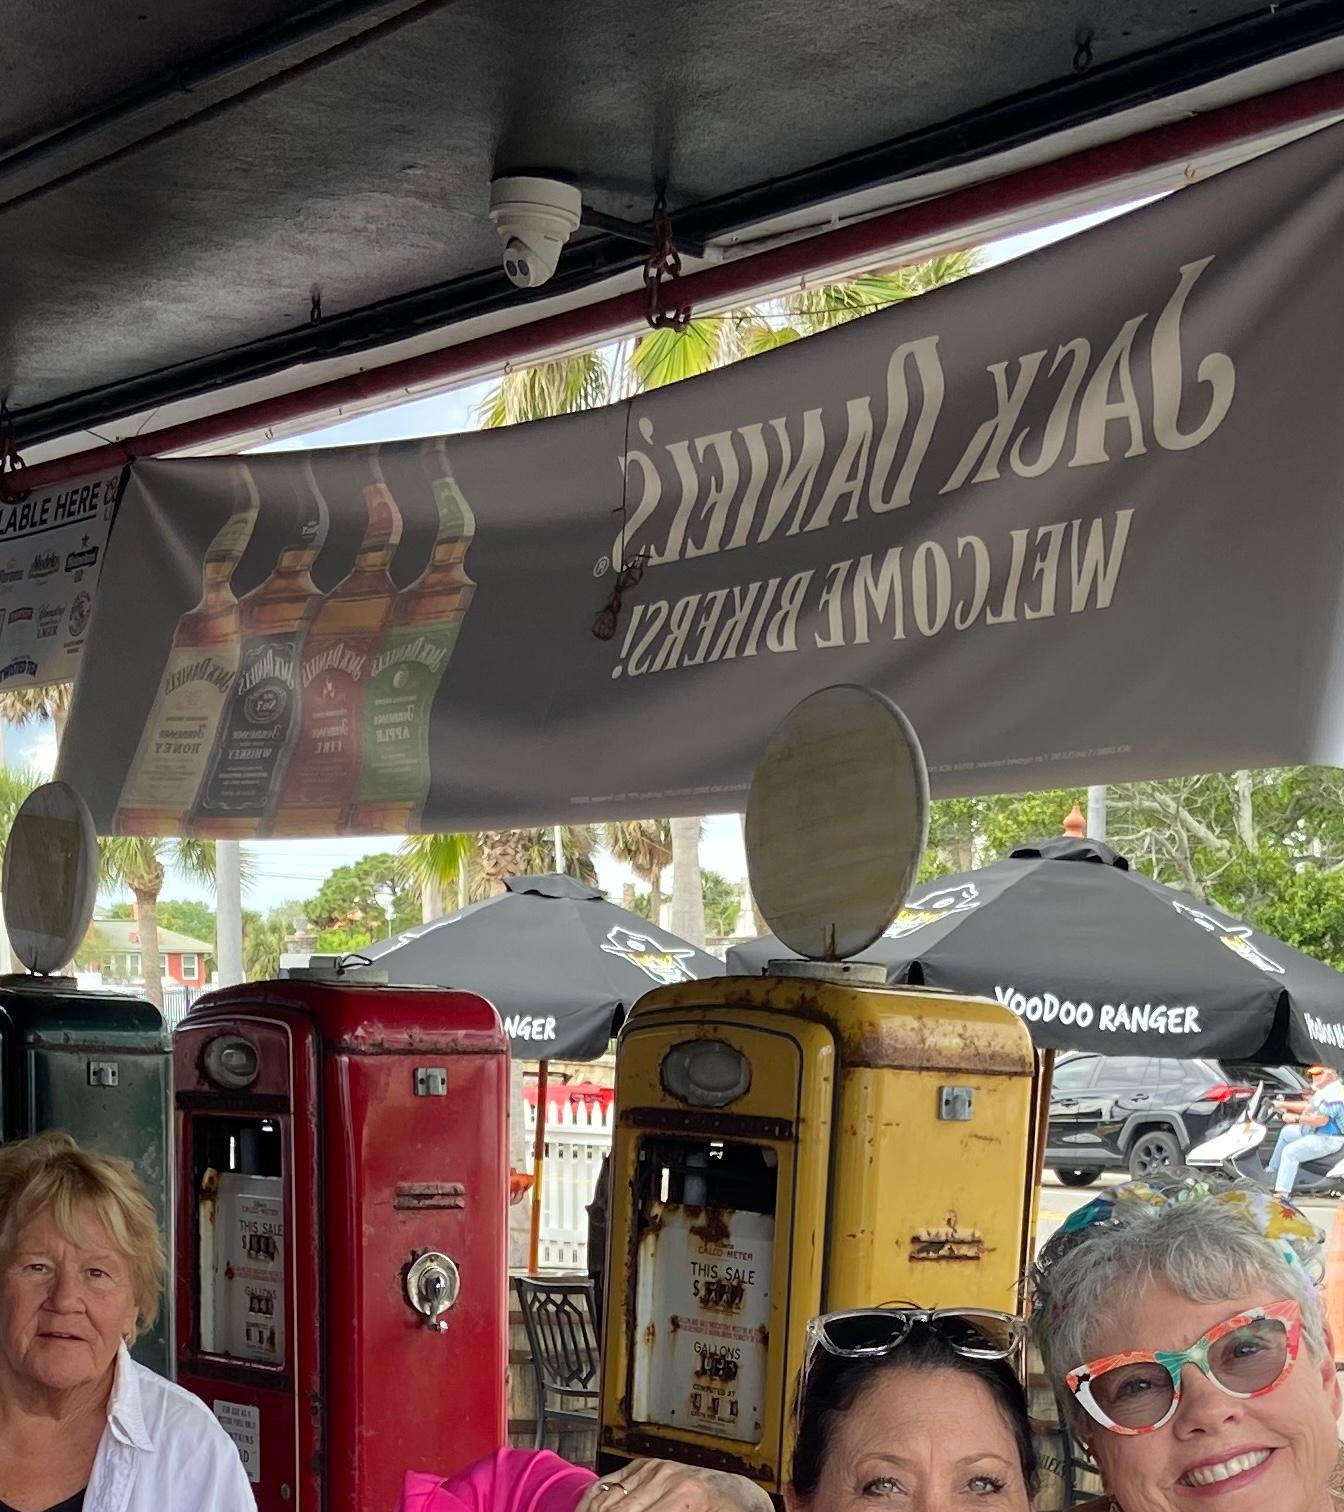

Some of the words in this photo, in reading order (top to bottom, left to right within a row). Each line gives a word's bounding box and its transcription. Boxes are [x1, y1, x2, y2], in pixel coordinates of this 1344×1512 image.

[54, 480, 102, 521] HERE
[994, 986, 1094, 1028] VOODOO
[1099, 1003, 1202, 1034] RANGER
[691, 1261, 718, 1279] THIS
[725, 1266, 756, 1285] SALE
[693, 1341, 741, 1361] GALLONS
